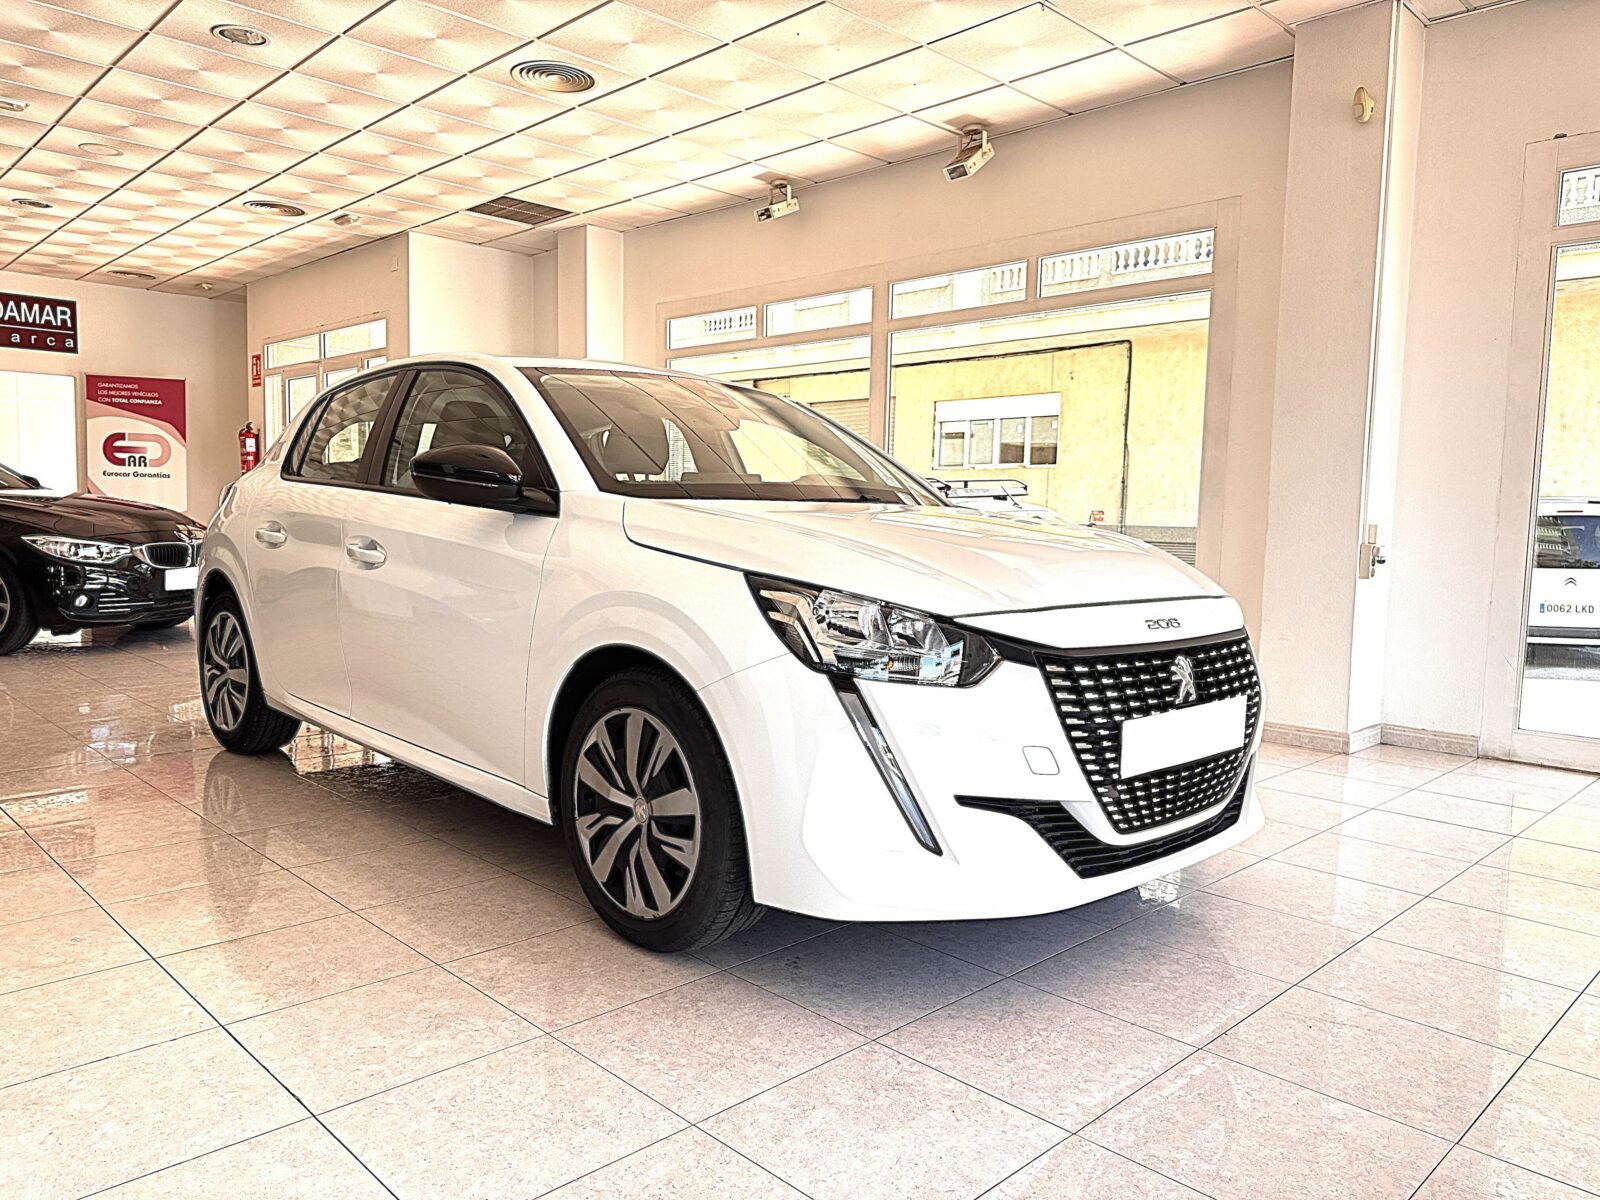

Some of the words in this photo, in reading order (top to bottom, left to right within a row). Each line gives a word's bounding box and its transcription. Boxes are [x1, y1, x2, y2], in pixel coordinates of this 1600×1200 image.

[0, 300, 72, 327] AMAR
[102, 470, 130, 478] Eurocar
[132, 471, 171, 479] Garantías
[1546, 604, 1572, 613] 0062
[1575, 604, 1595, 614] LKD
